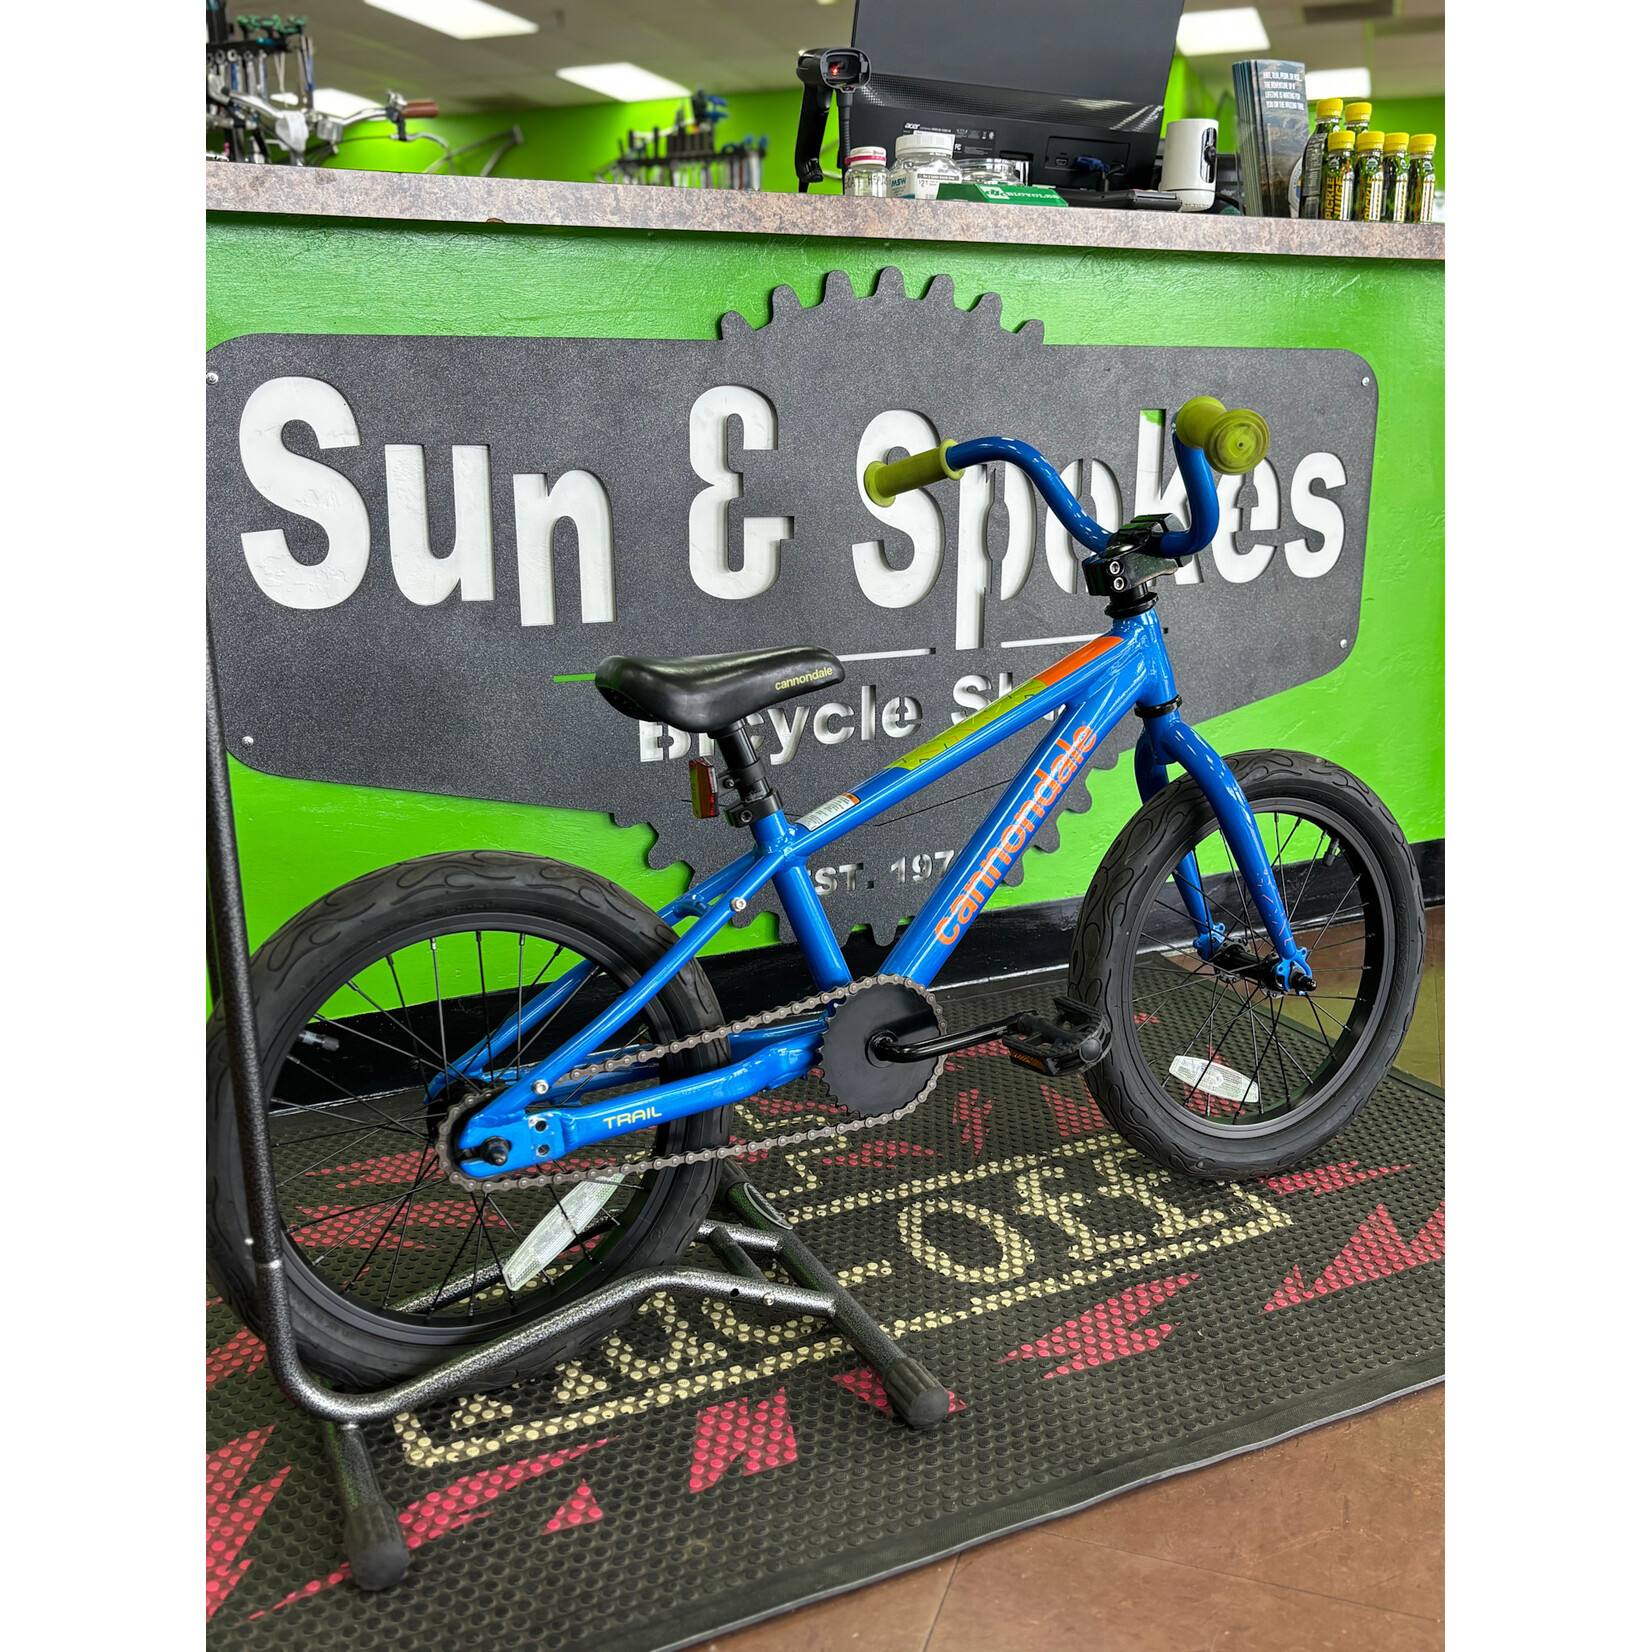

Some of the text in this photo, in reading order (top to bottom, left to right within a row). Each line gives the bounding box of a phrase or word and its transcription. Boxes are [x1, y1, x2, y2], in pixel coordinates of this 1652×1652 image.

[904, 122, 920, 130] acer
[891, 177, 907, 187] MSW
[1325, 177, 1335, 220] PICKLE
[239, 376, 1348, 650] Sun & Spokes
[774, 666, 833, 691] cannondale
[935, 726, 1097, 945] cannondale
[810, 842, 955, 896] ST. 197
[603, 1106, 662, 1129] TRAIL
